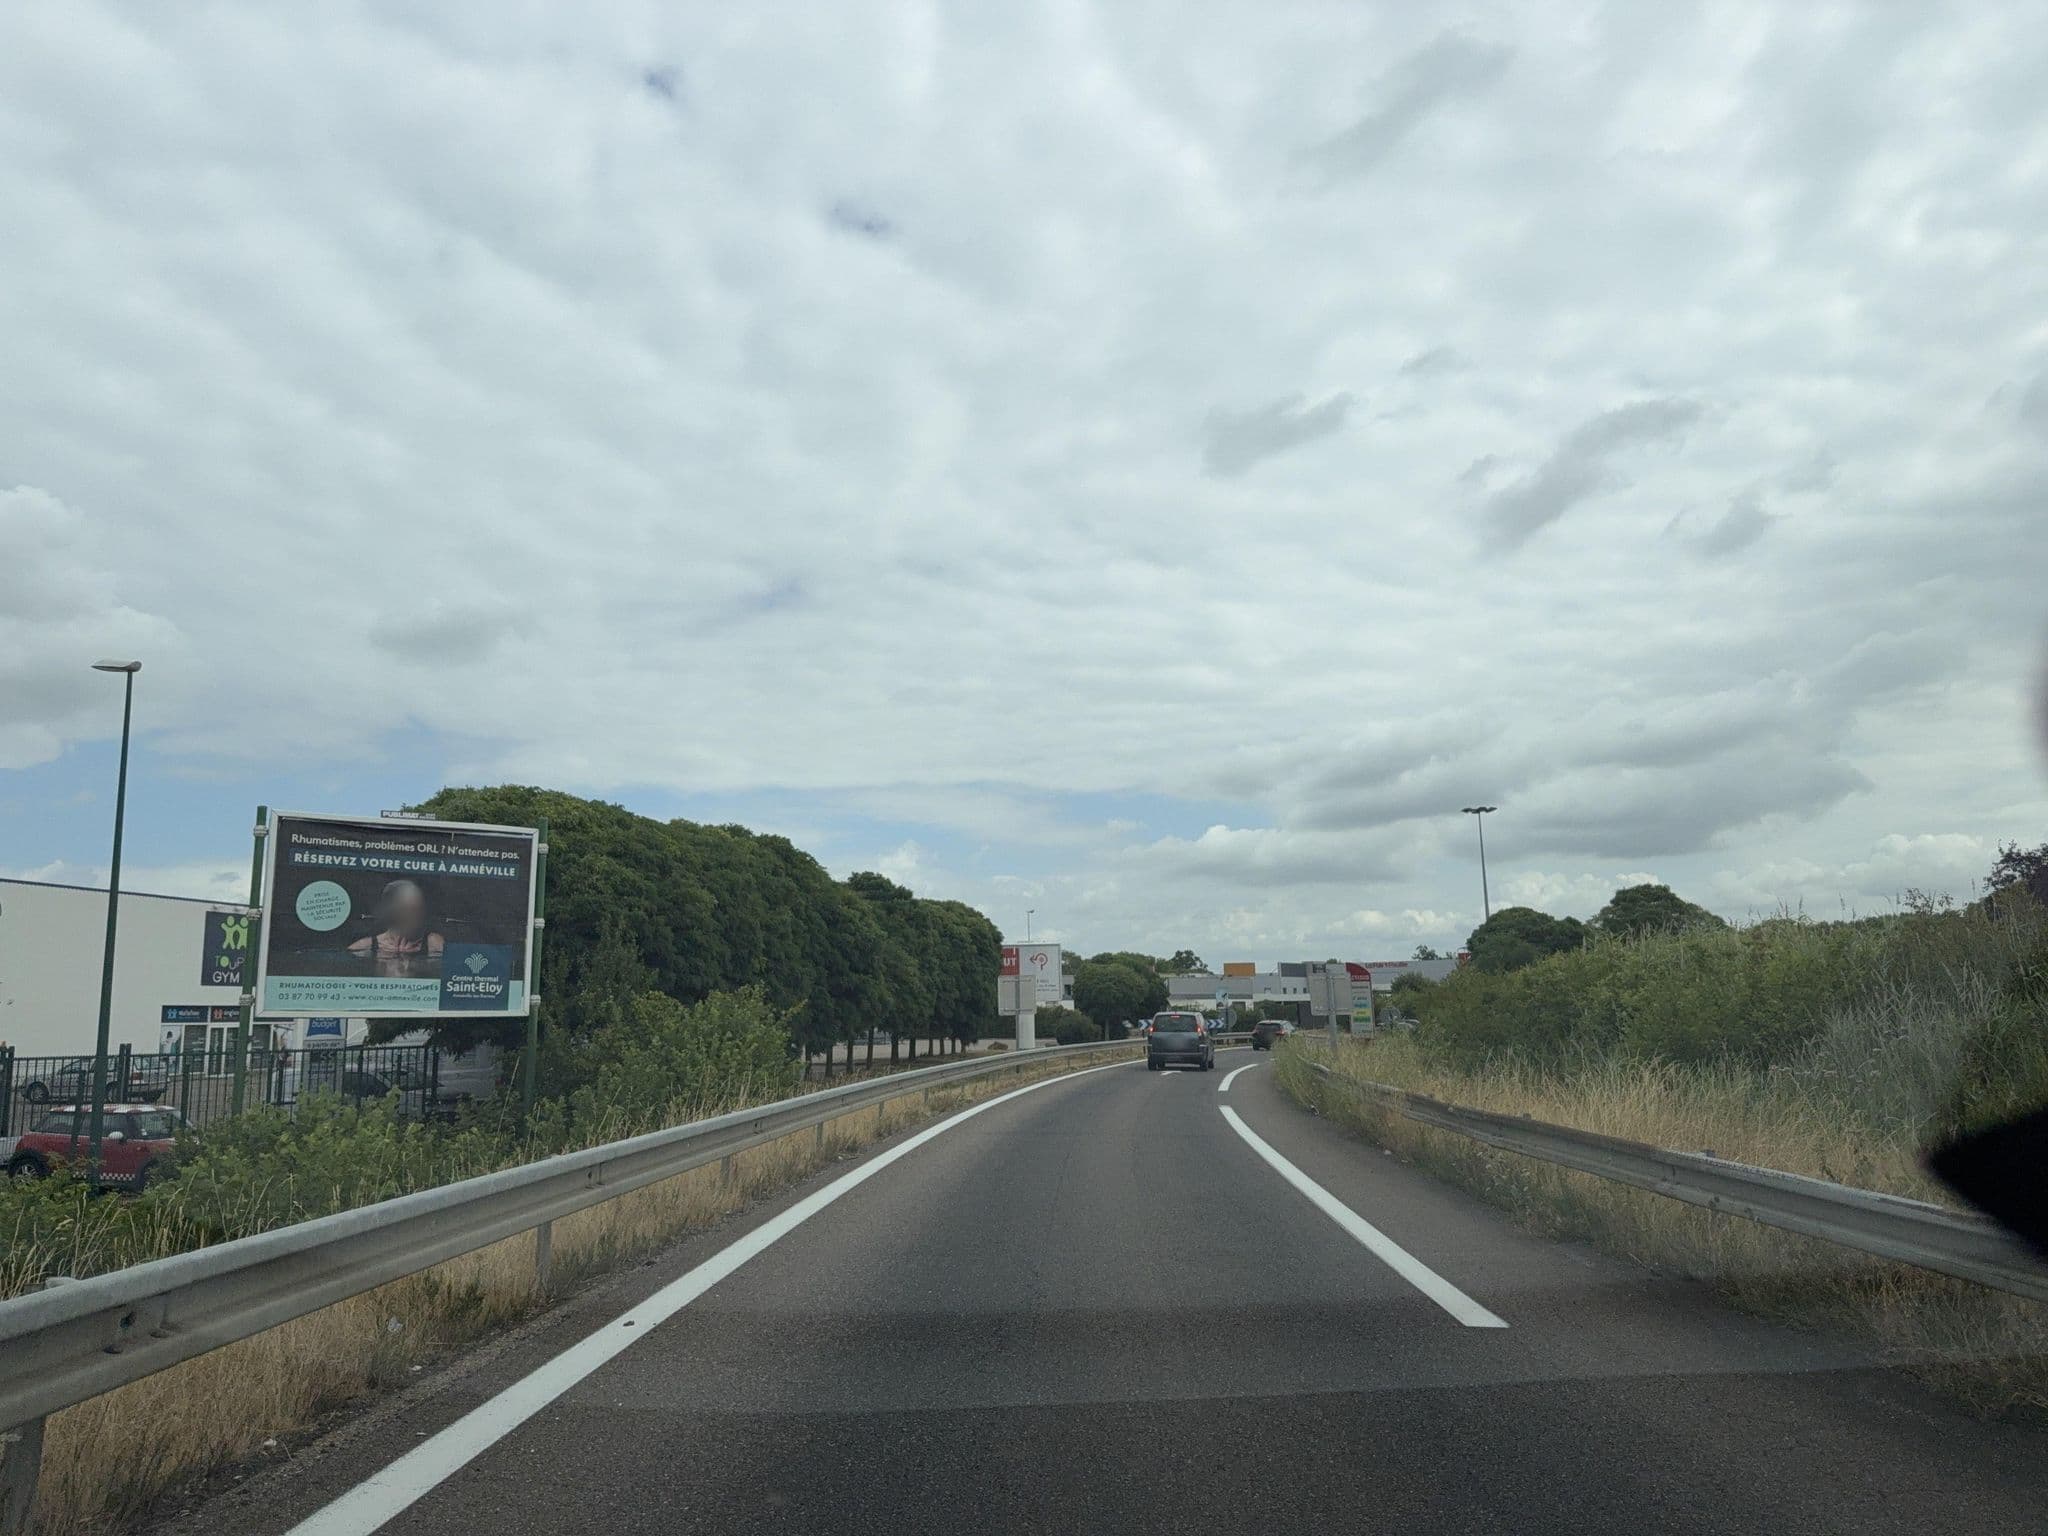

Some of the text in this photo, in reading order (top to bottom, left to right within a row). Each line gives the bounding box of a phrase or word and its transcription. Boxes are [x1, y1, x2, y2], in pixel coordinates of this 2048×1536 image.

[291, 833, 520, 860] Rhumatismes, problèmes ORL ? N'attendez pas.
[294, 850, 516, 877] RÉSERVEZ VOTRE CURE À AMNÉVILLE
[212, 970, 241, 984] GYM
[474, 975, 500, 983] thermal
[279, 982, 346, 990] RHUMATOLOGIE
[380, 983, 439, 992] RESPIRATOIRES
[446, 981, 504, 995] Saint-Eloy
